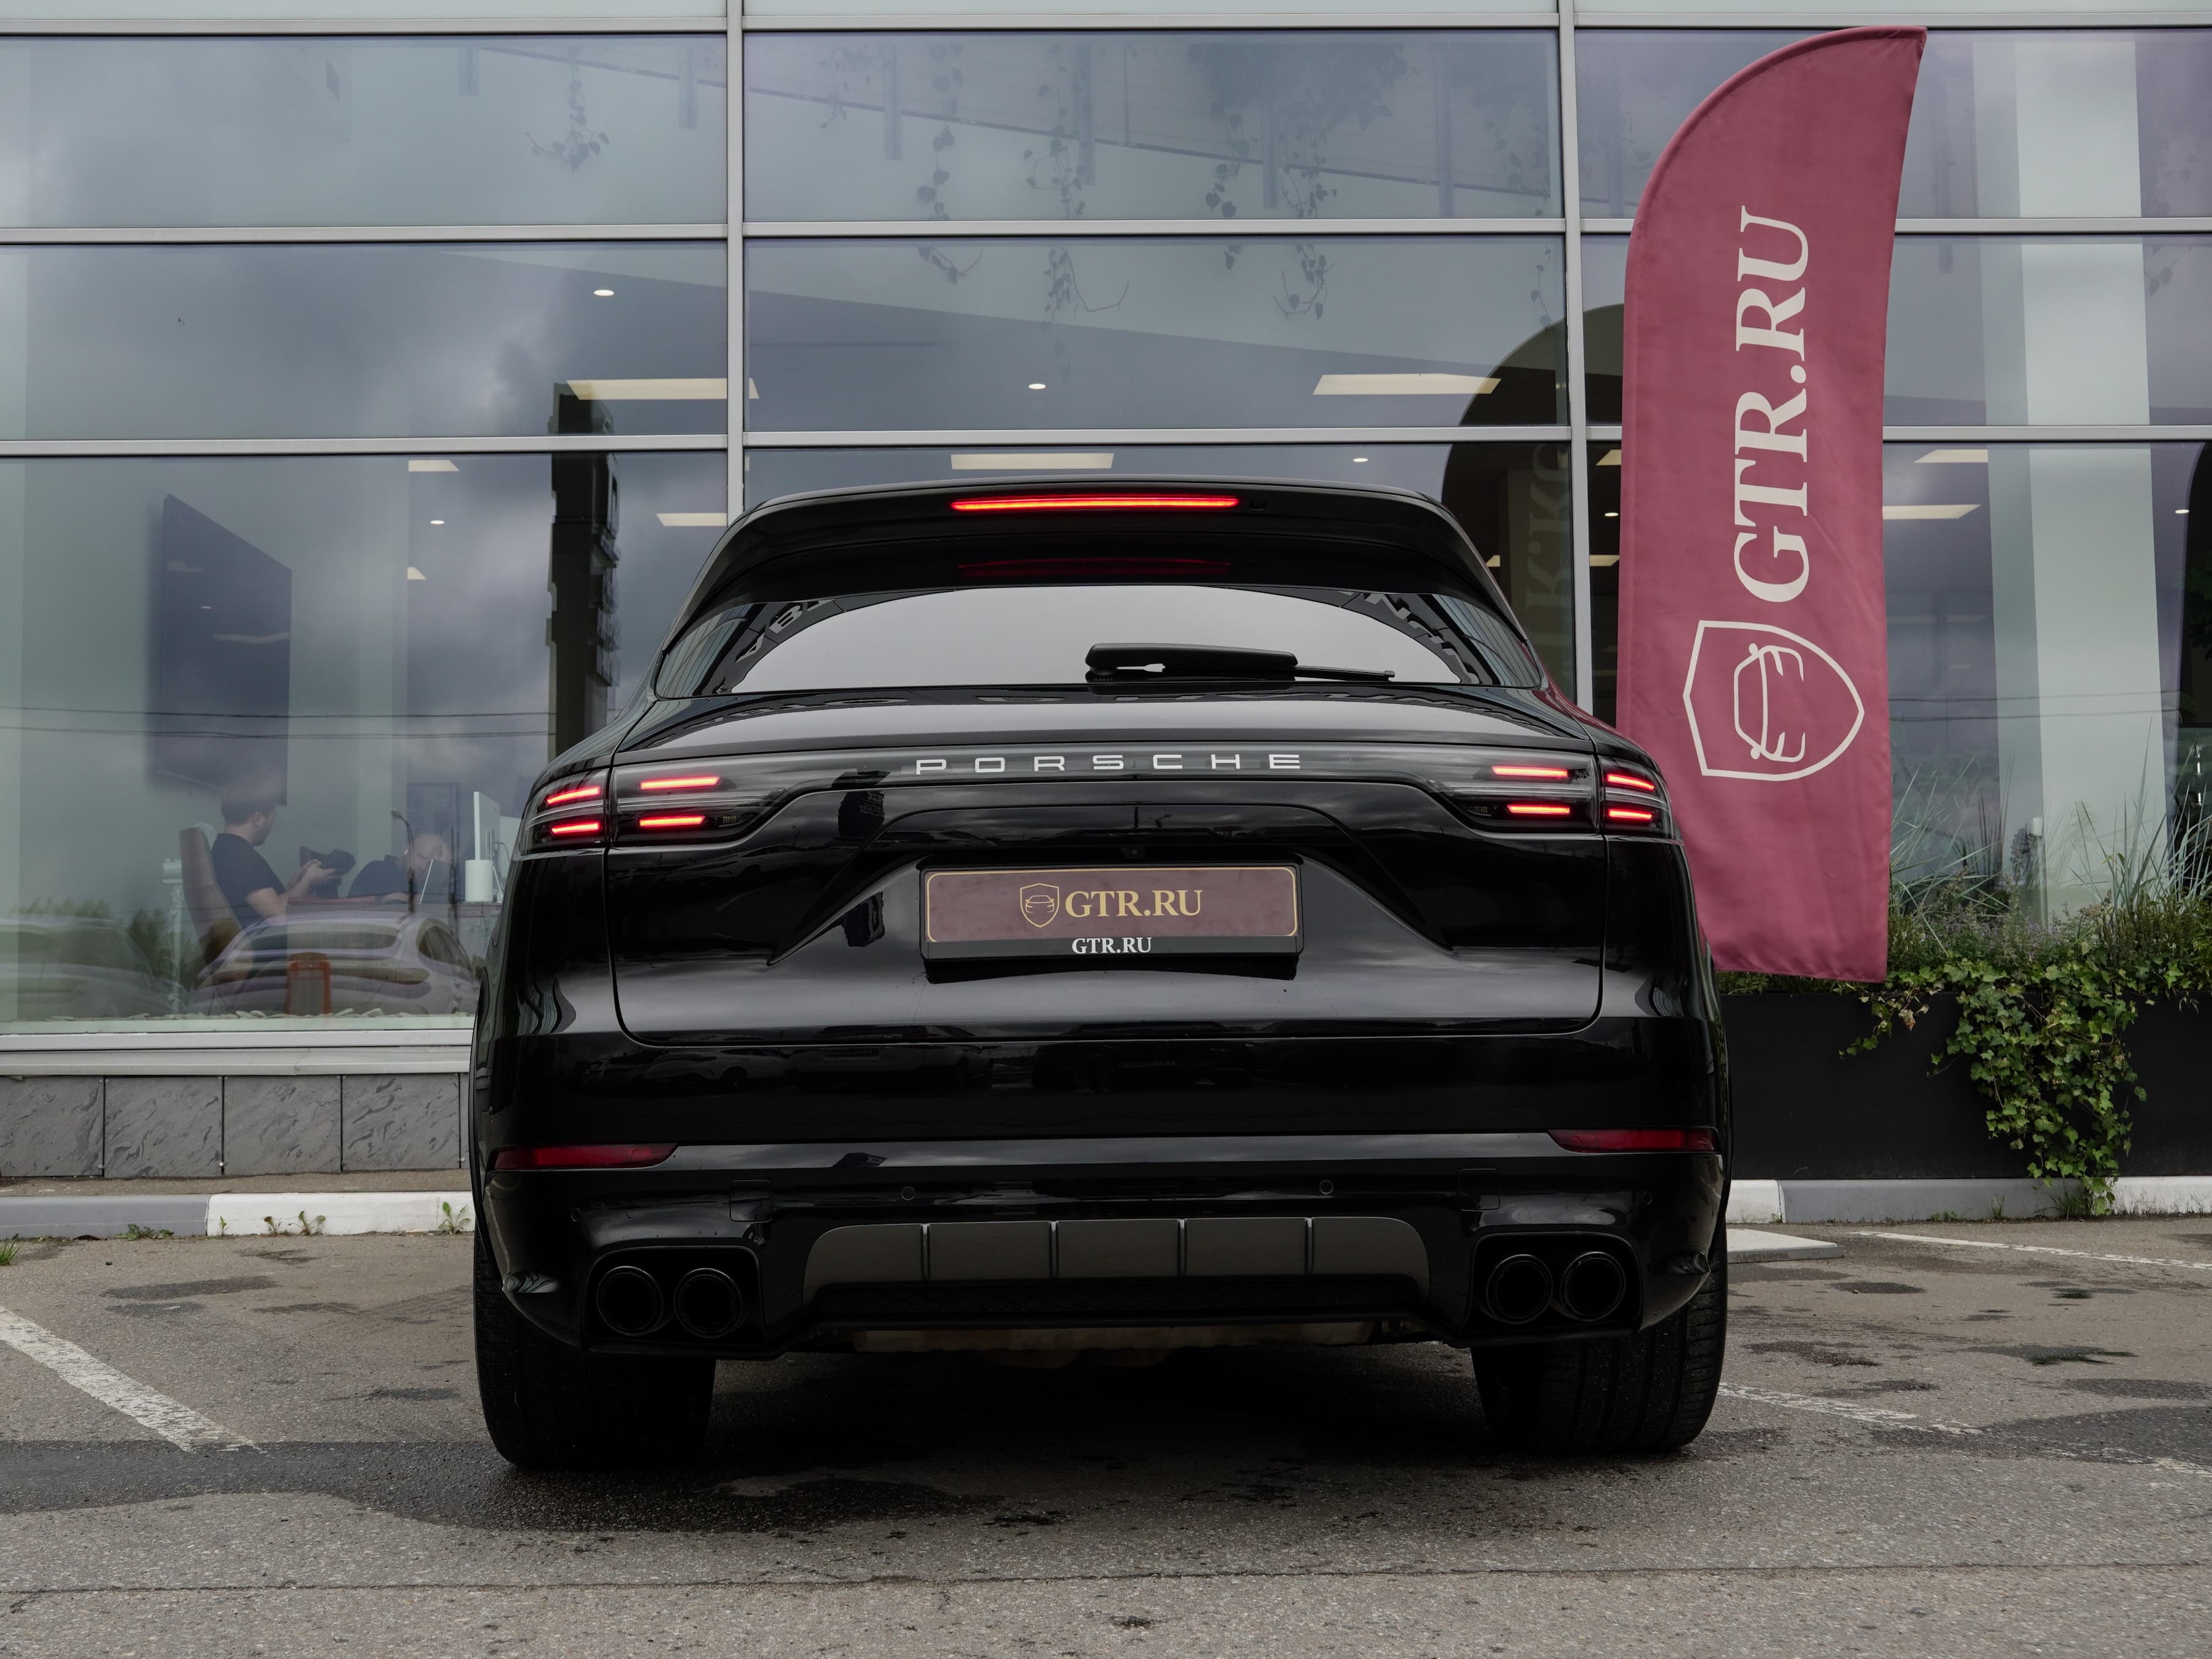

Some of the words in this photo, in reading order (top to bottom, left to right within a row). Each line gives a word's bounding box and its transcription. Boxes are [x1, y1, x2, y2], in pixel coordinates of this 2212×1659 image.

[1733, 205, 1810, 603] GTR.RU
[915, 754, 1301, 775] PORSCHE
[1065, 889, 1204, 918] GTR.RU
[1071, 937, 1153, 955] GTR.RU
